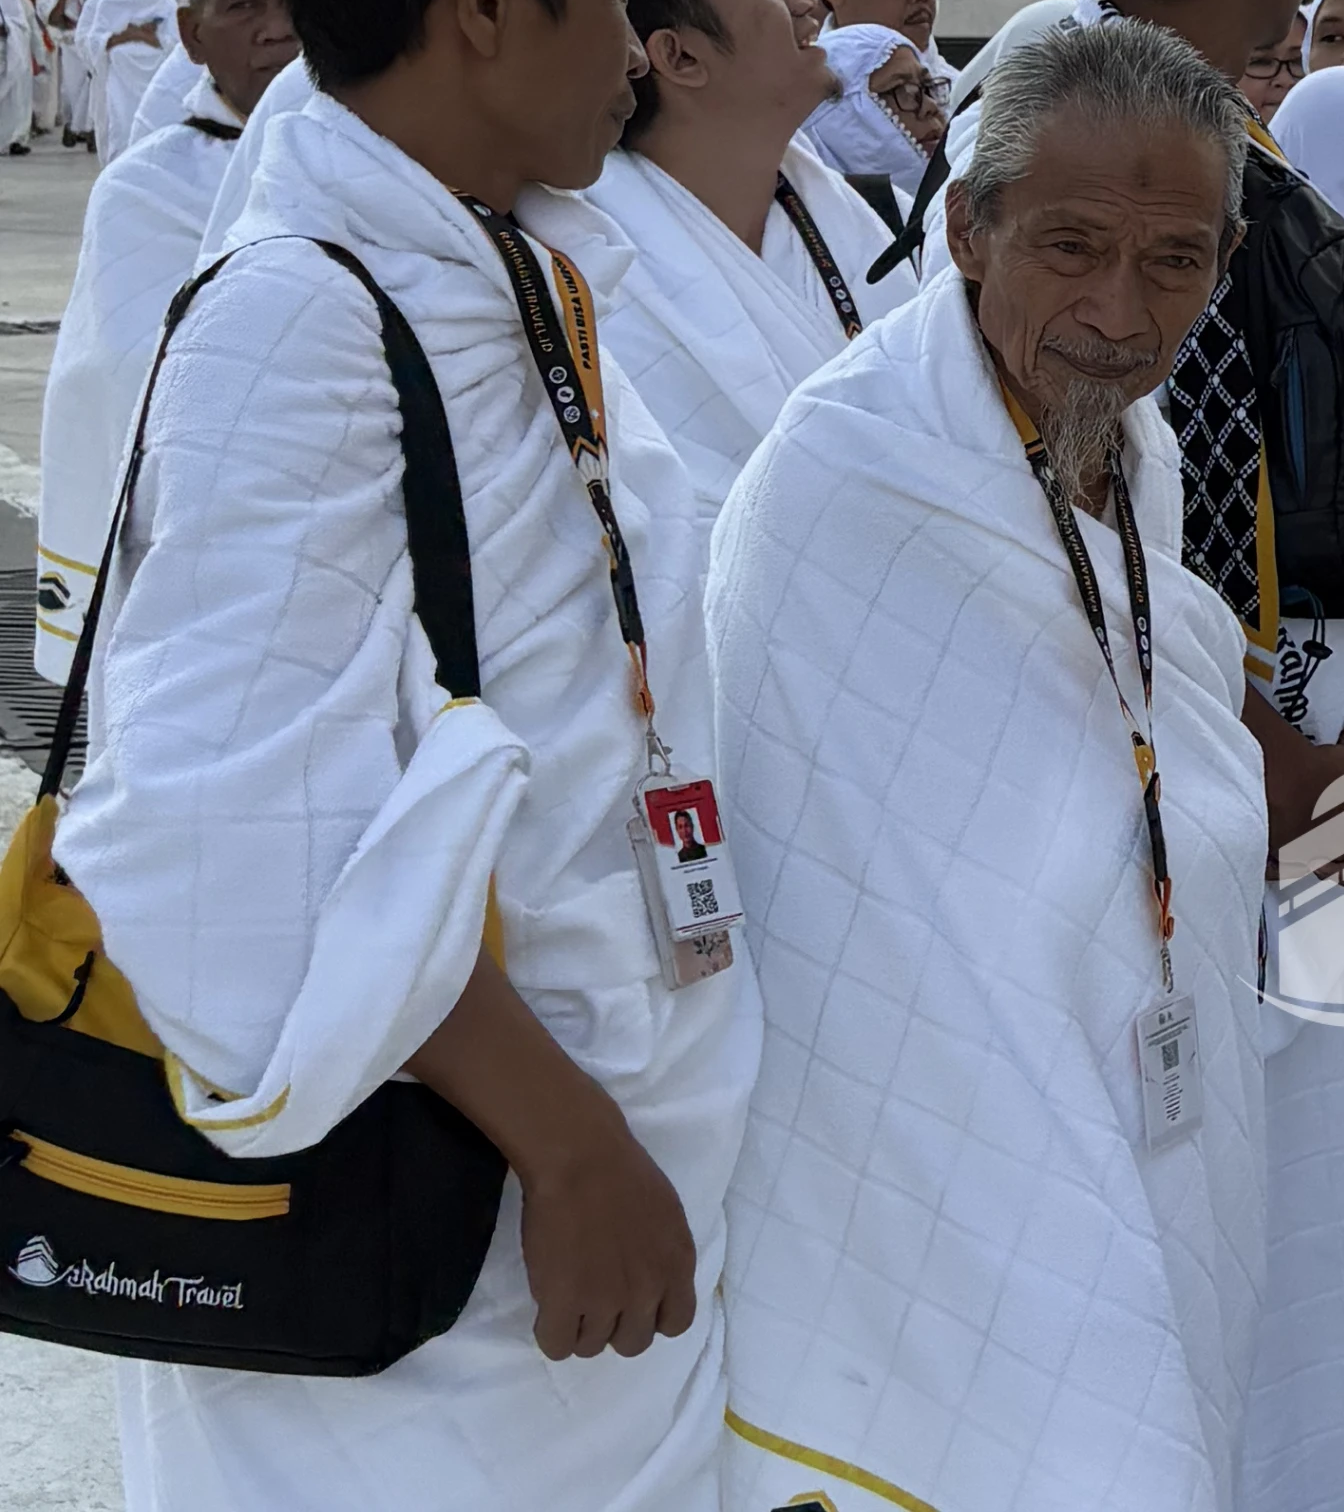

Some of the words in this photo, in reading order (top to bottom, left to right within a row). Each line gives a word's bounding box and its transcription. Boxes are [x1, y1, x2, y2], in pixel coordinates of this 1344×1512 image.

[572, 296, 586, 328] BISA
[577, 329, 592, 371] PASTI
[67, 1259, 164, 1304] Rahmah
